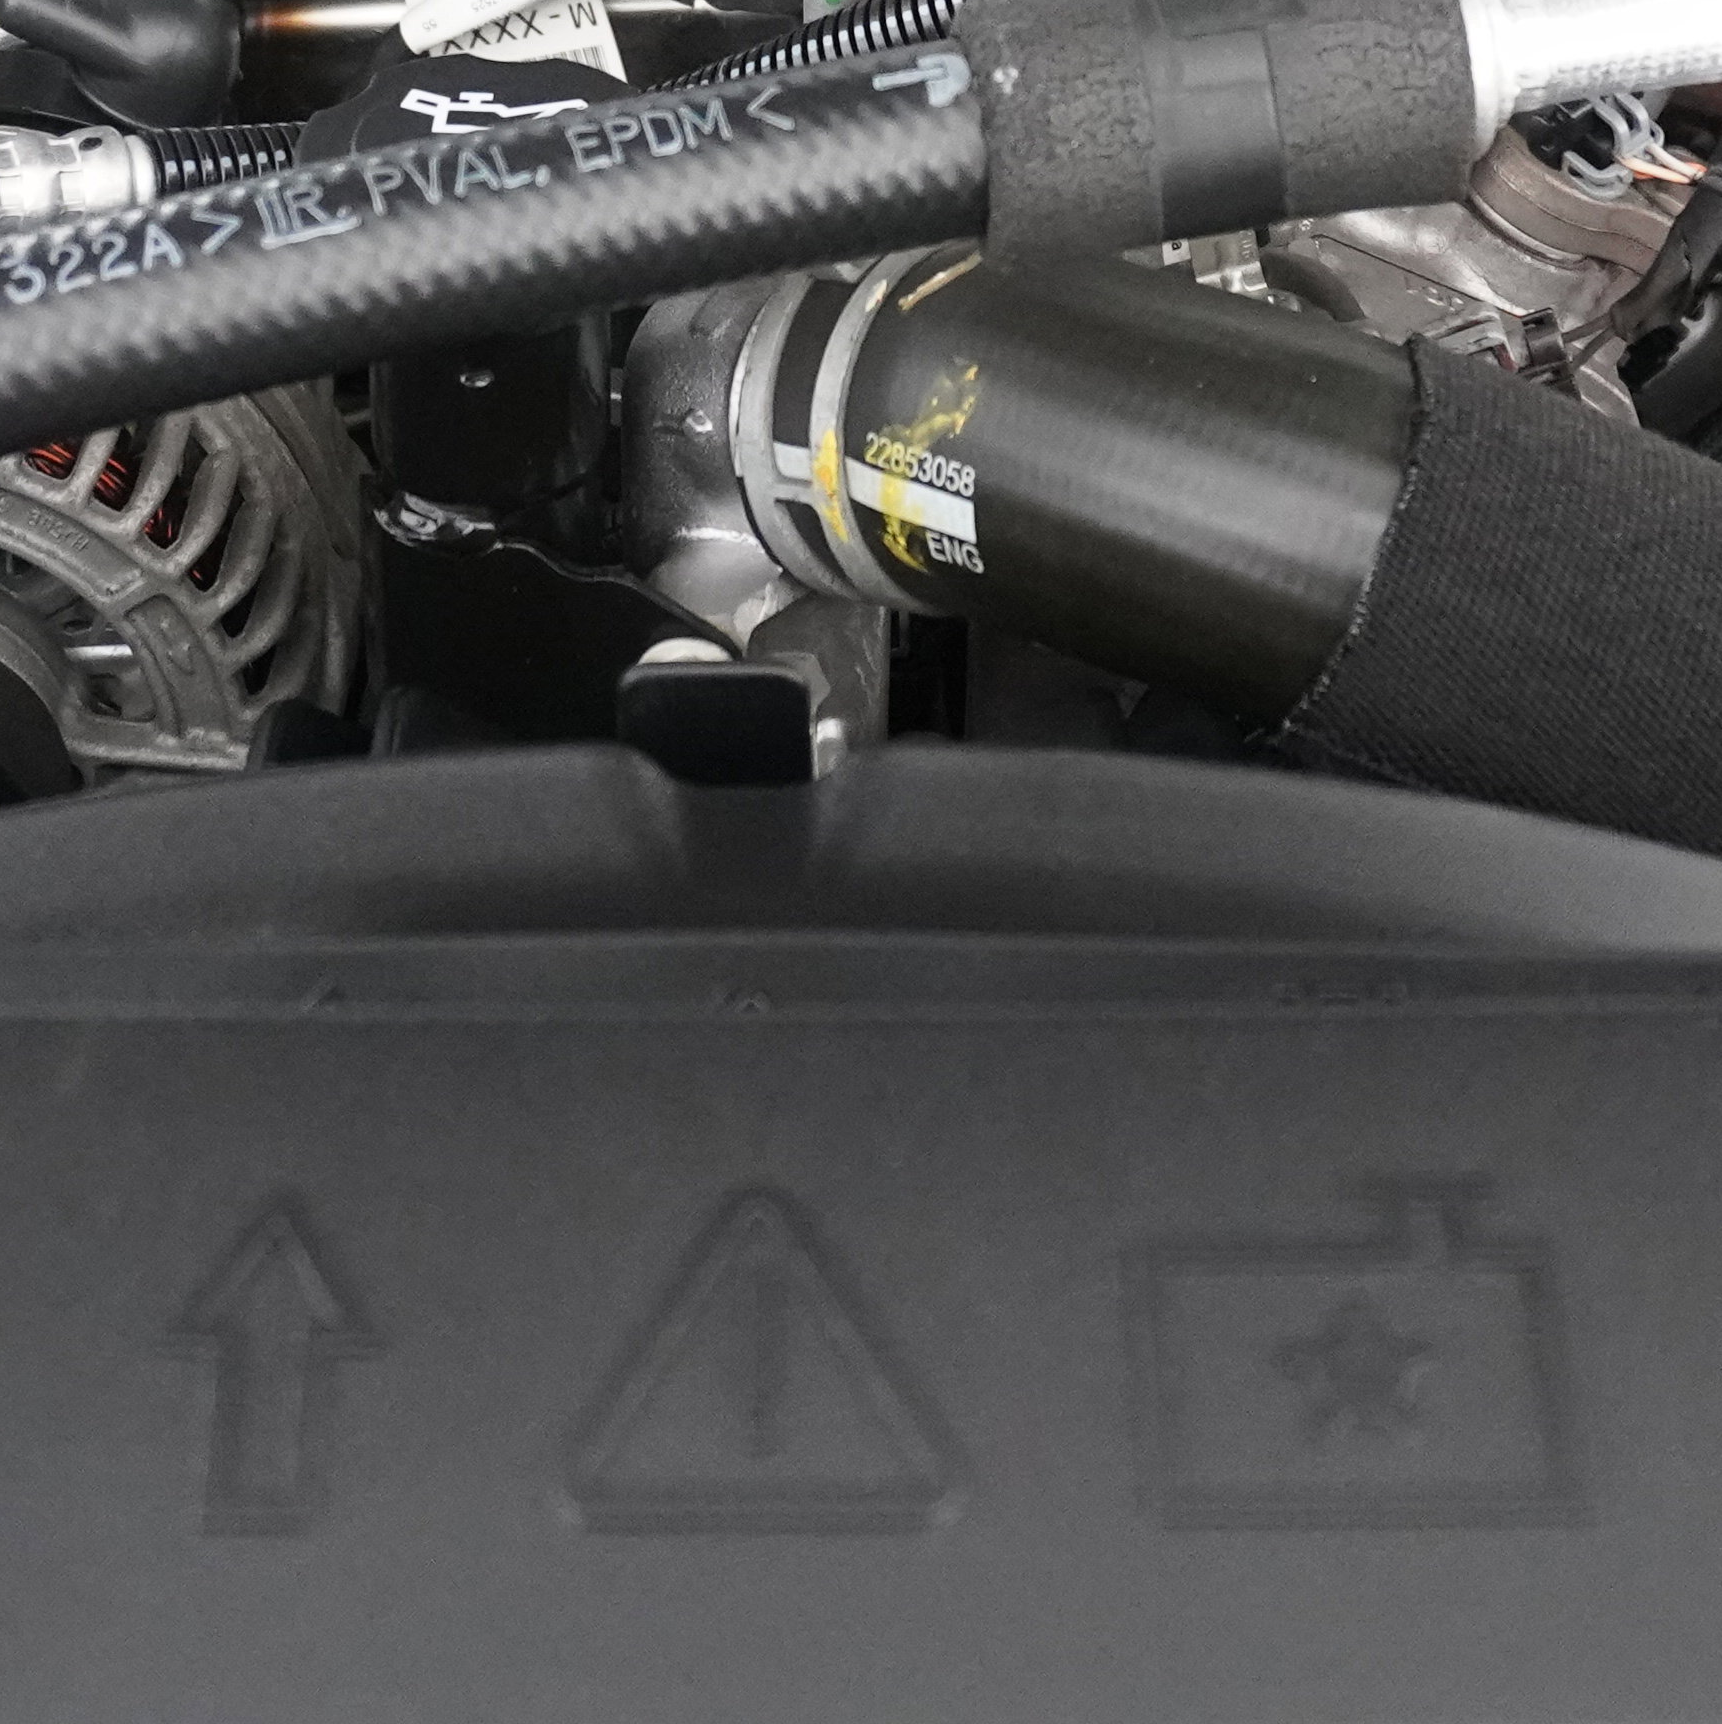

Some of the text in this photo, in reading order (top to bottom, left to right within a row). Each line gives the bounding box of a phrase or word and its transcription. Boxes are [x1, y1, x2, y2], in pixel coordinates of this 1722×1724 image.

[566, 96, 734, 174] EPDM
[863, 431, 976, 498] 22853058
[925, 529, 985, 575] ENG
